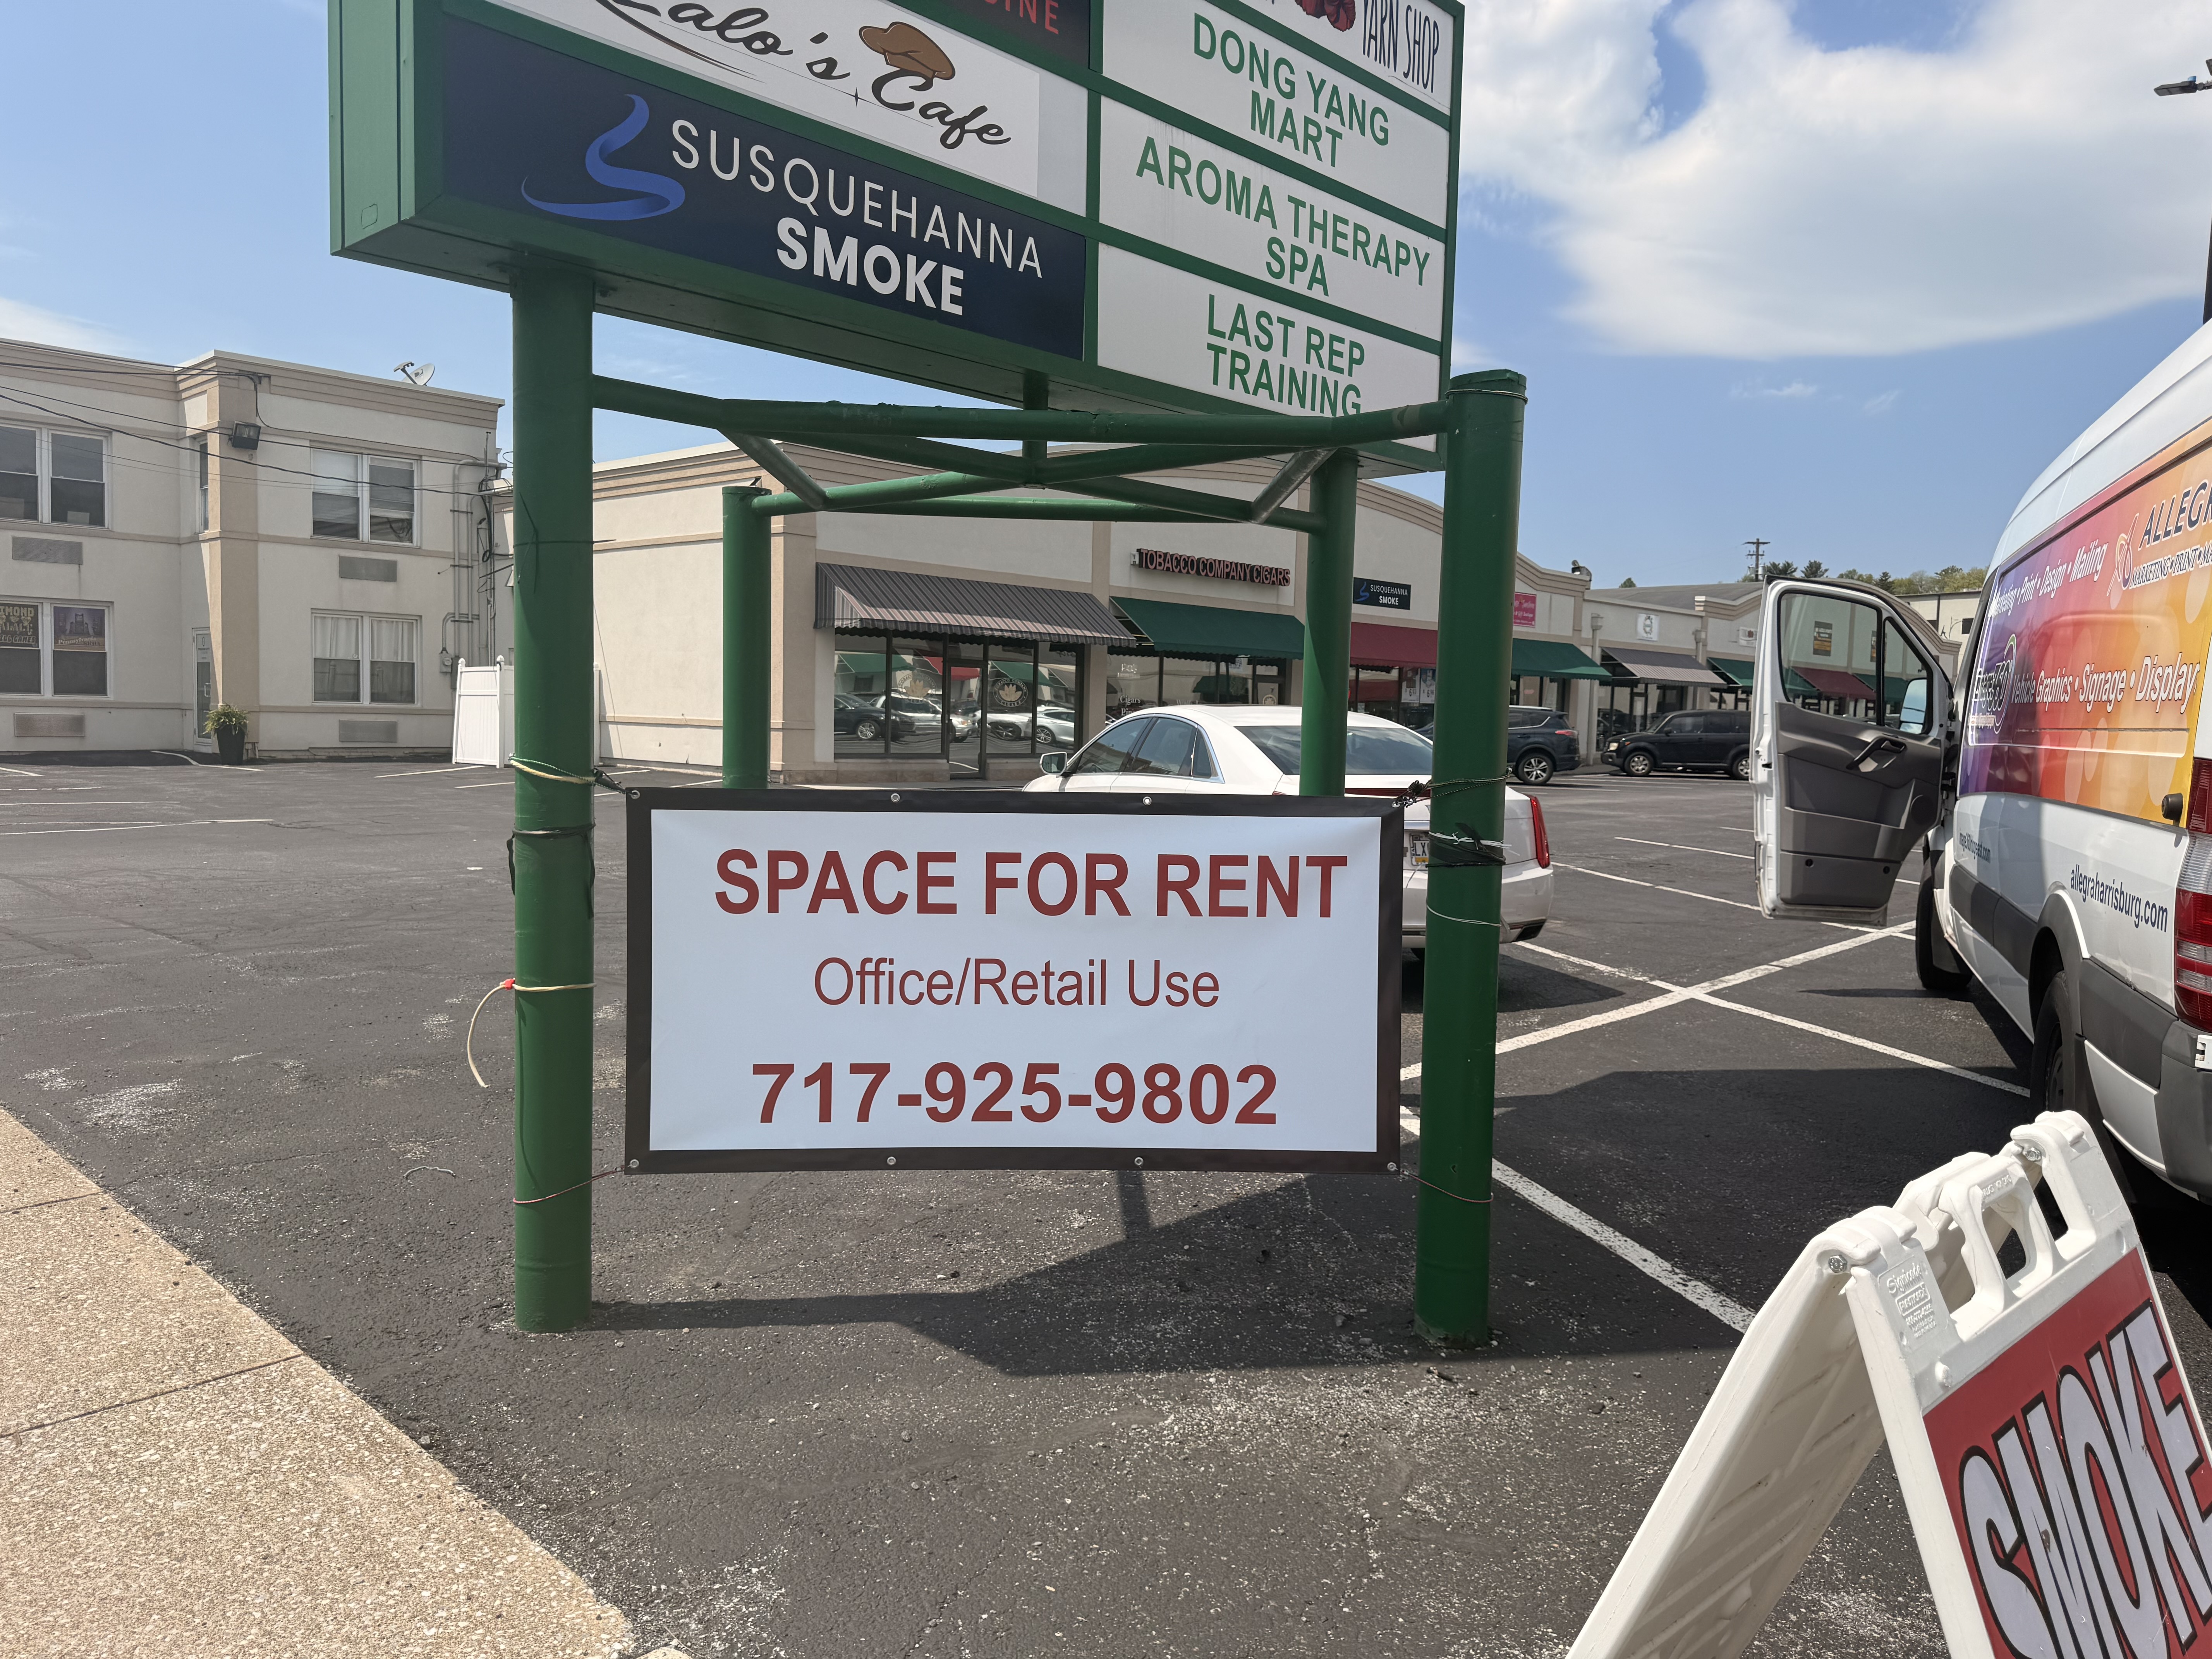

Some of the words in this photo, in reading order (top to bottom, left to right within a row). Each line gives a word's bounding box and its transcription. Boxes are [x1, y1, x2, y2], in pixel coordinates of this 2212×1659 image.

[1194, 12, 1296, 100] DONG
[1306, 70, 1389, 146] YANG
[1363, 0, 1399, 73] YARN
[1403, 5, 1439, 93] SHOP
[871, 68, 1012, 149] Cafe
[1250, 89, 1343, 168] MART
[672, 119, 1042, 278] SUSQUEHANNA
[1136, 136, 1278, 230] AROMA
[1287, 194, 1430, 286] THERAPY
[776, 216, 964, 316] SMOKE
[1266, 236, 1329, 297] SPA
[1207, 293, 1295, 358] LAST
[1305, 326, 1365, 377] REP
[1206, 342, 1361, 417] TRAINING
[1137, 548, 1197, 575] TOBACCO
[1199, 557, 1252, 581] COMPANY
[1253, 564, 1291, 586] CIGARS
[1370, 584, 1408, 596] SUSQUEHANNA
[1379, 596, 1399, 605] SMOKE
[2018, 572, 2039, 605] Print
[2039, 559, 2067, 599] Design
[2069, 539, 2109, 582] Mailing
[1120, 695, 1141, 706] Cigars
[2011, 672, 2036, 704] Vehicle
[2035, 668, 2073, 712] Graphics
[2079, 663, 2127, 713] Signage
[715, 848, 958, 915] SPACE
[985, 852, 1132, 917] FOR
[1157, 854, 1348, 919] RENT
[2071, 864, 2168, 933] allegraharrisburg.com
[813, 957, 1108, 1007] Office/Retail
[1128, 965, 1220, 1008] Use
[751, 1061, 1278, 1126] 717-925-9802
[1959, 1297, 2212, 1659] SMOKE
